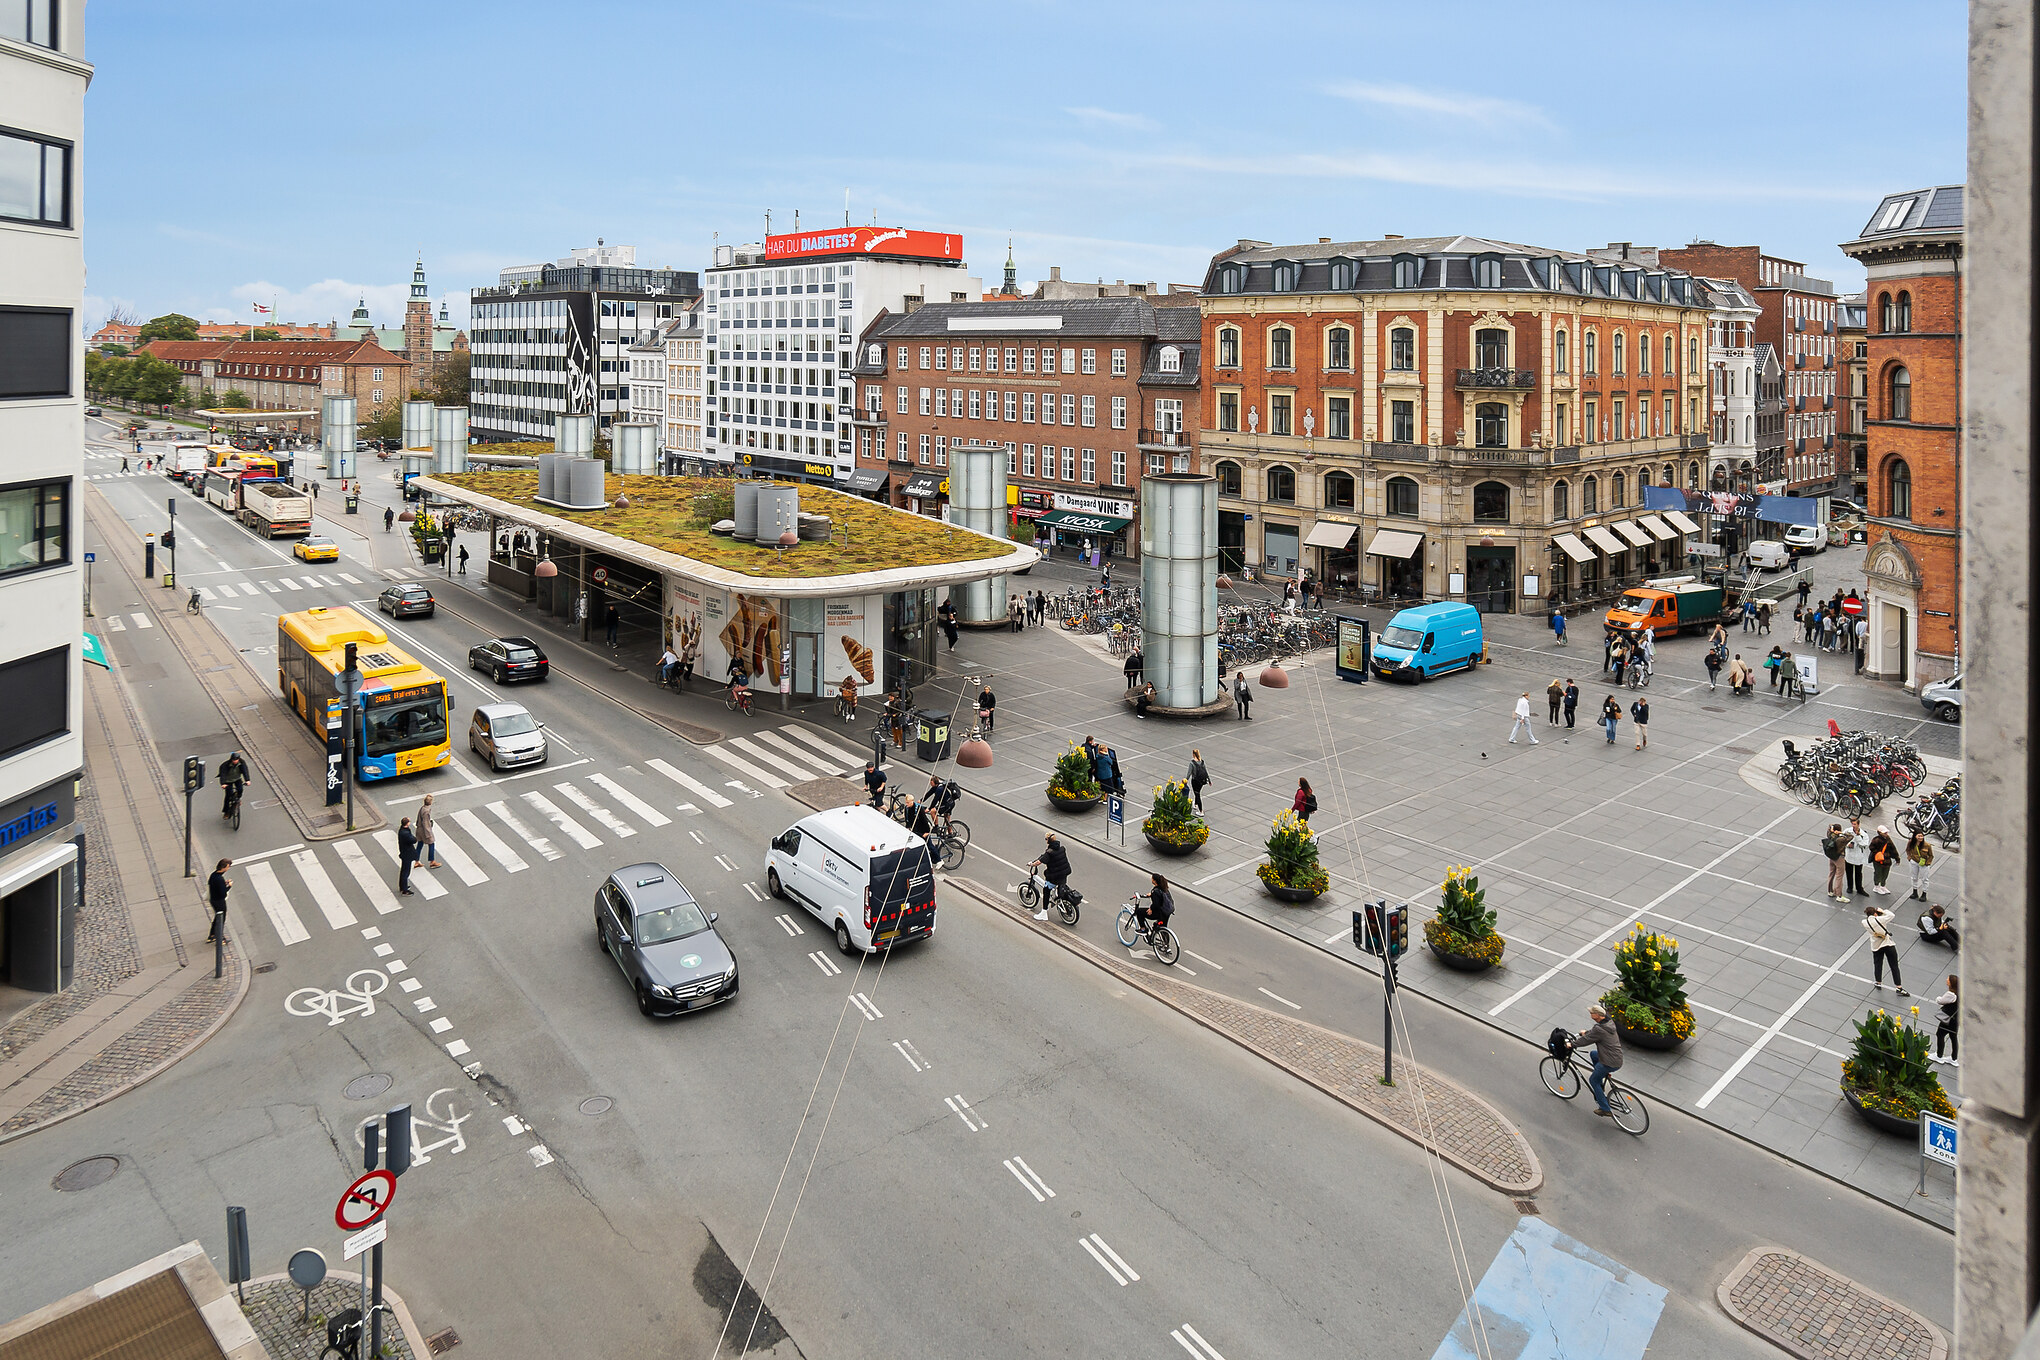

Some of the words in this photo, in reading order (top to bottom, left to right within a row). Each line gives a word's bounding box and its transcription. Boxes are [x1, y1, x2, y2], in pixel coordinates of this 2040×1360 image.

[767, 240, 784, 254] HAR
[787, 239, 799, 253] DU
[801, 233, 857, 251] DIABETES?
[864, 229, 907, 252] diabetes.dk
[645, 284, 665, 297] Djøf
[805, 463, 824, 475] Netto
[1066, 495, 1096, 508] Damgaard
[1097, 500, 1120, 515] VINE
[1058, 515, 1110, 529] KIOSK
[1112, 799, 1120, 813] P
[0, 800, 58, 848] matas
[1933, 1147, 1956, 1161] Zone
